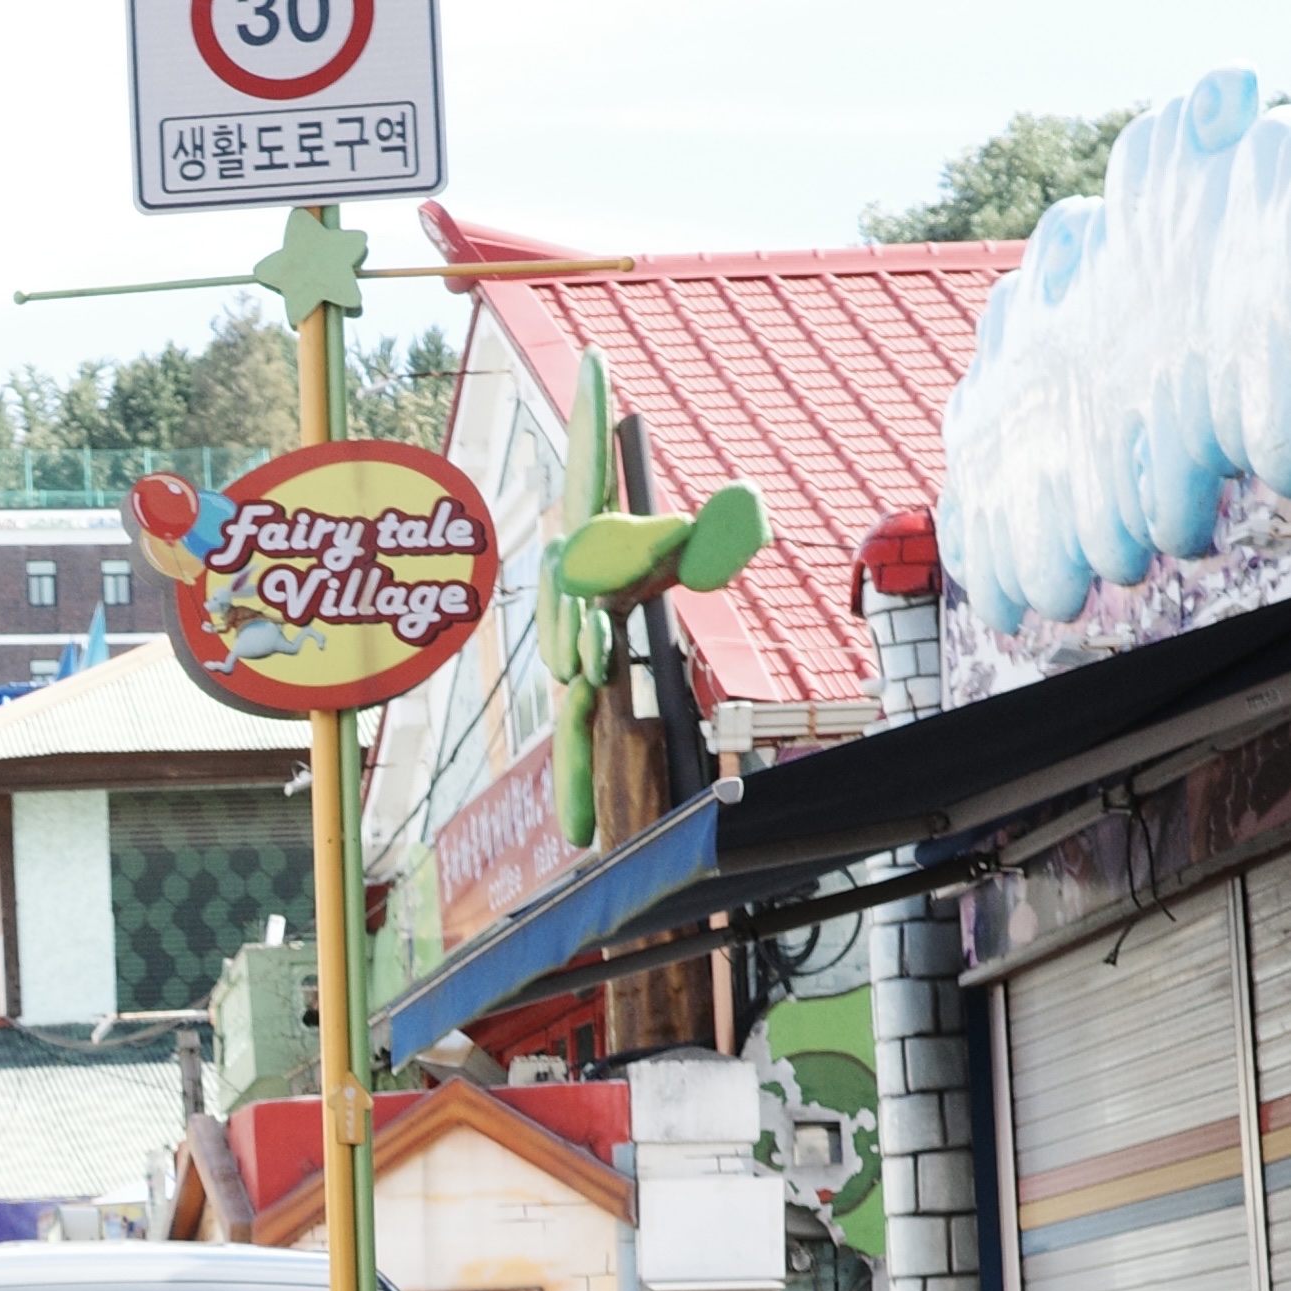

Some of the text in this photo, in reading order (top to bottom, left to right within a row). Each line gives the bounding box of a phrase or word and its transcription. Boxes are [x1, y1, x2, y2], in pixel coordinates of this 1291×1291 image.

[236, 0, 330, 46] 30
[171, 111, 409, 182] 생활도로구역
[210, 501, 475, 571] Fairy tale
[262, 567, 470, 639] Village
